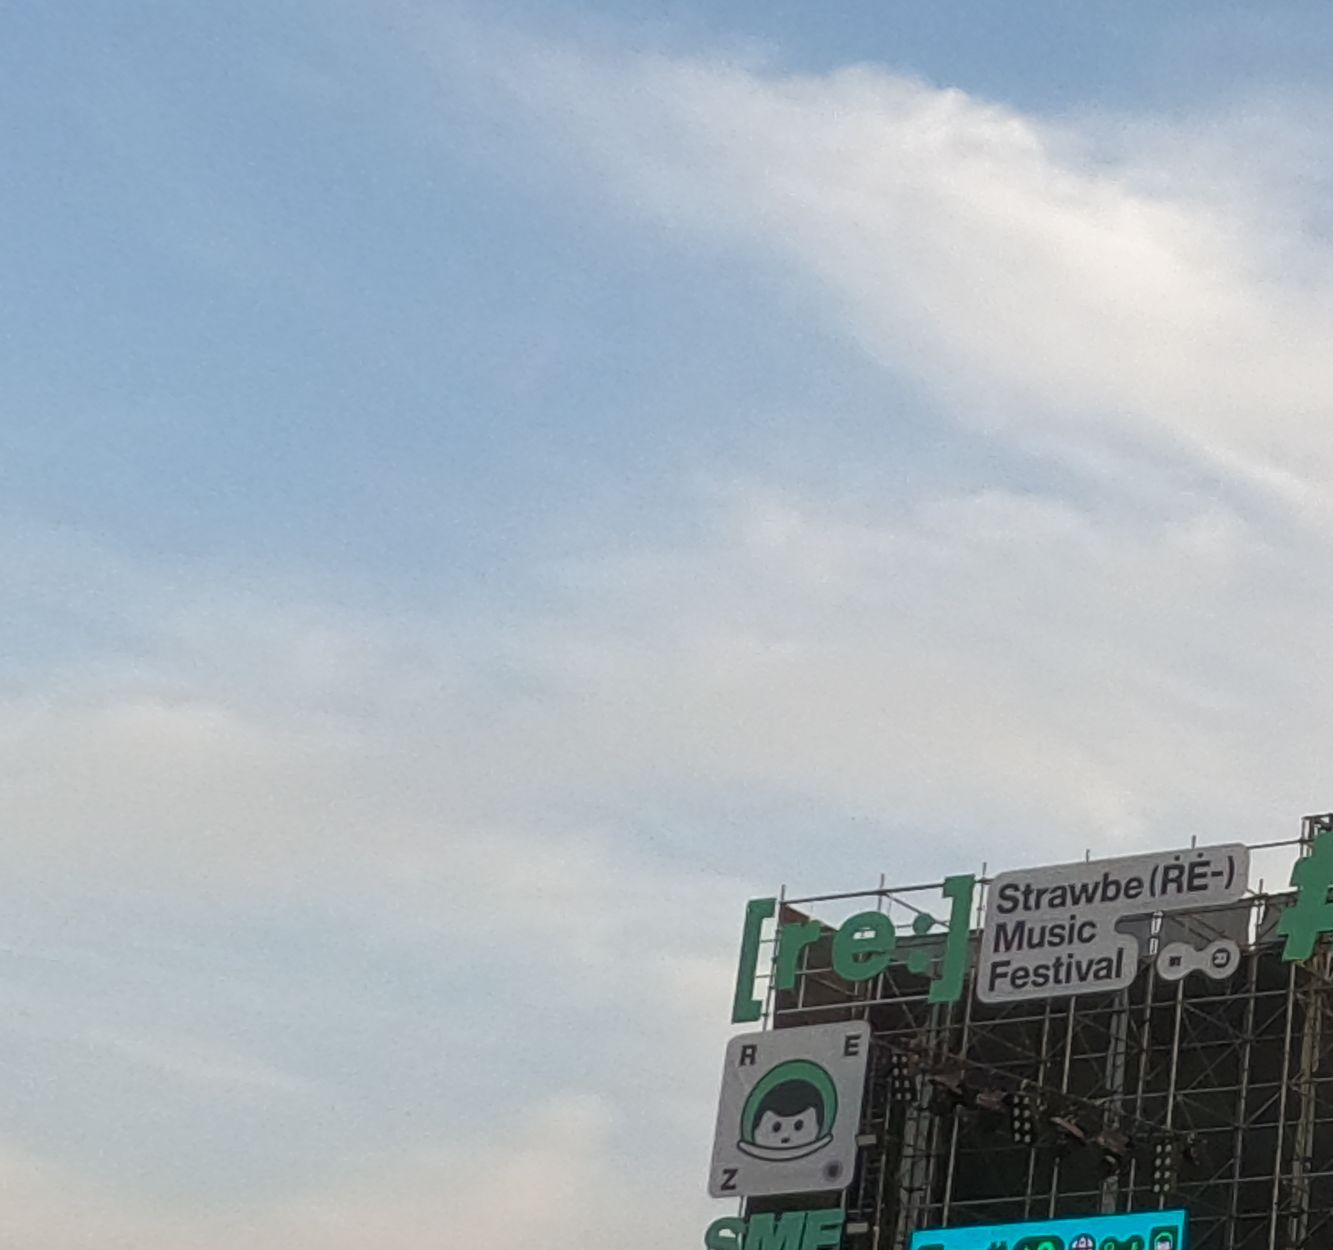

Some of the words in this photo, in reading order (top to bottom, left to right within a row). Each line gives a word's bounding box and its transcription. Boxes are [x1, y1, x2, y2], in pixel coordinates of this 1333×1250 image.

[993, 915, 1096, 953] Music
[988, 949, 1123, 992] Festival
[720, 1168, 738, 1191] Z
